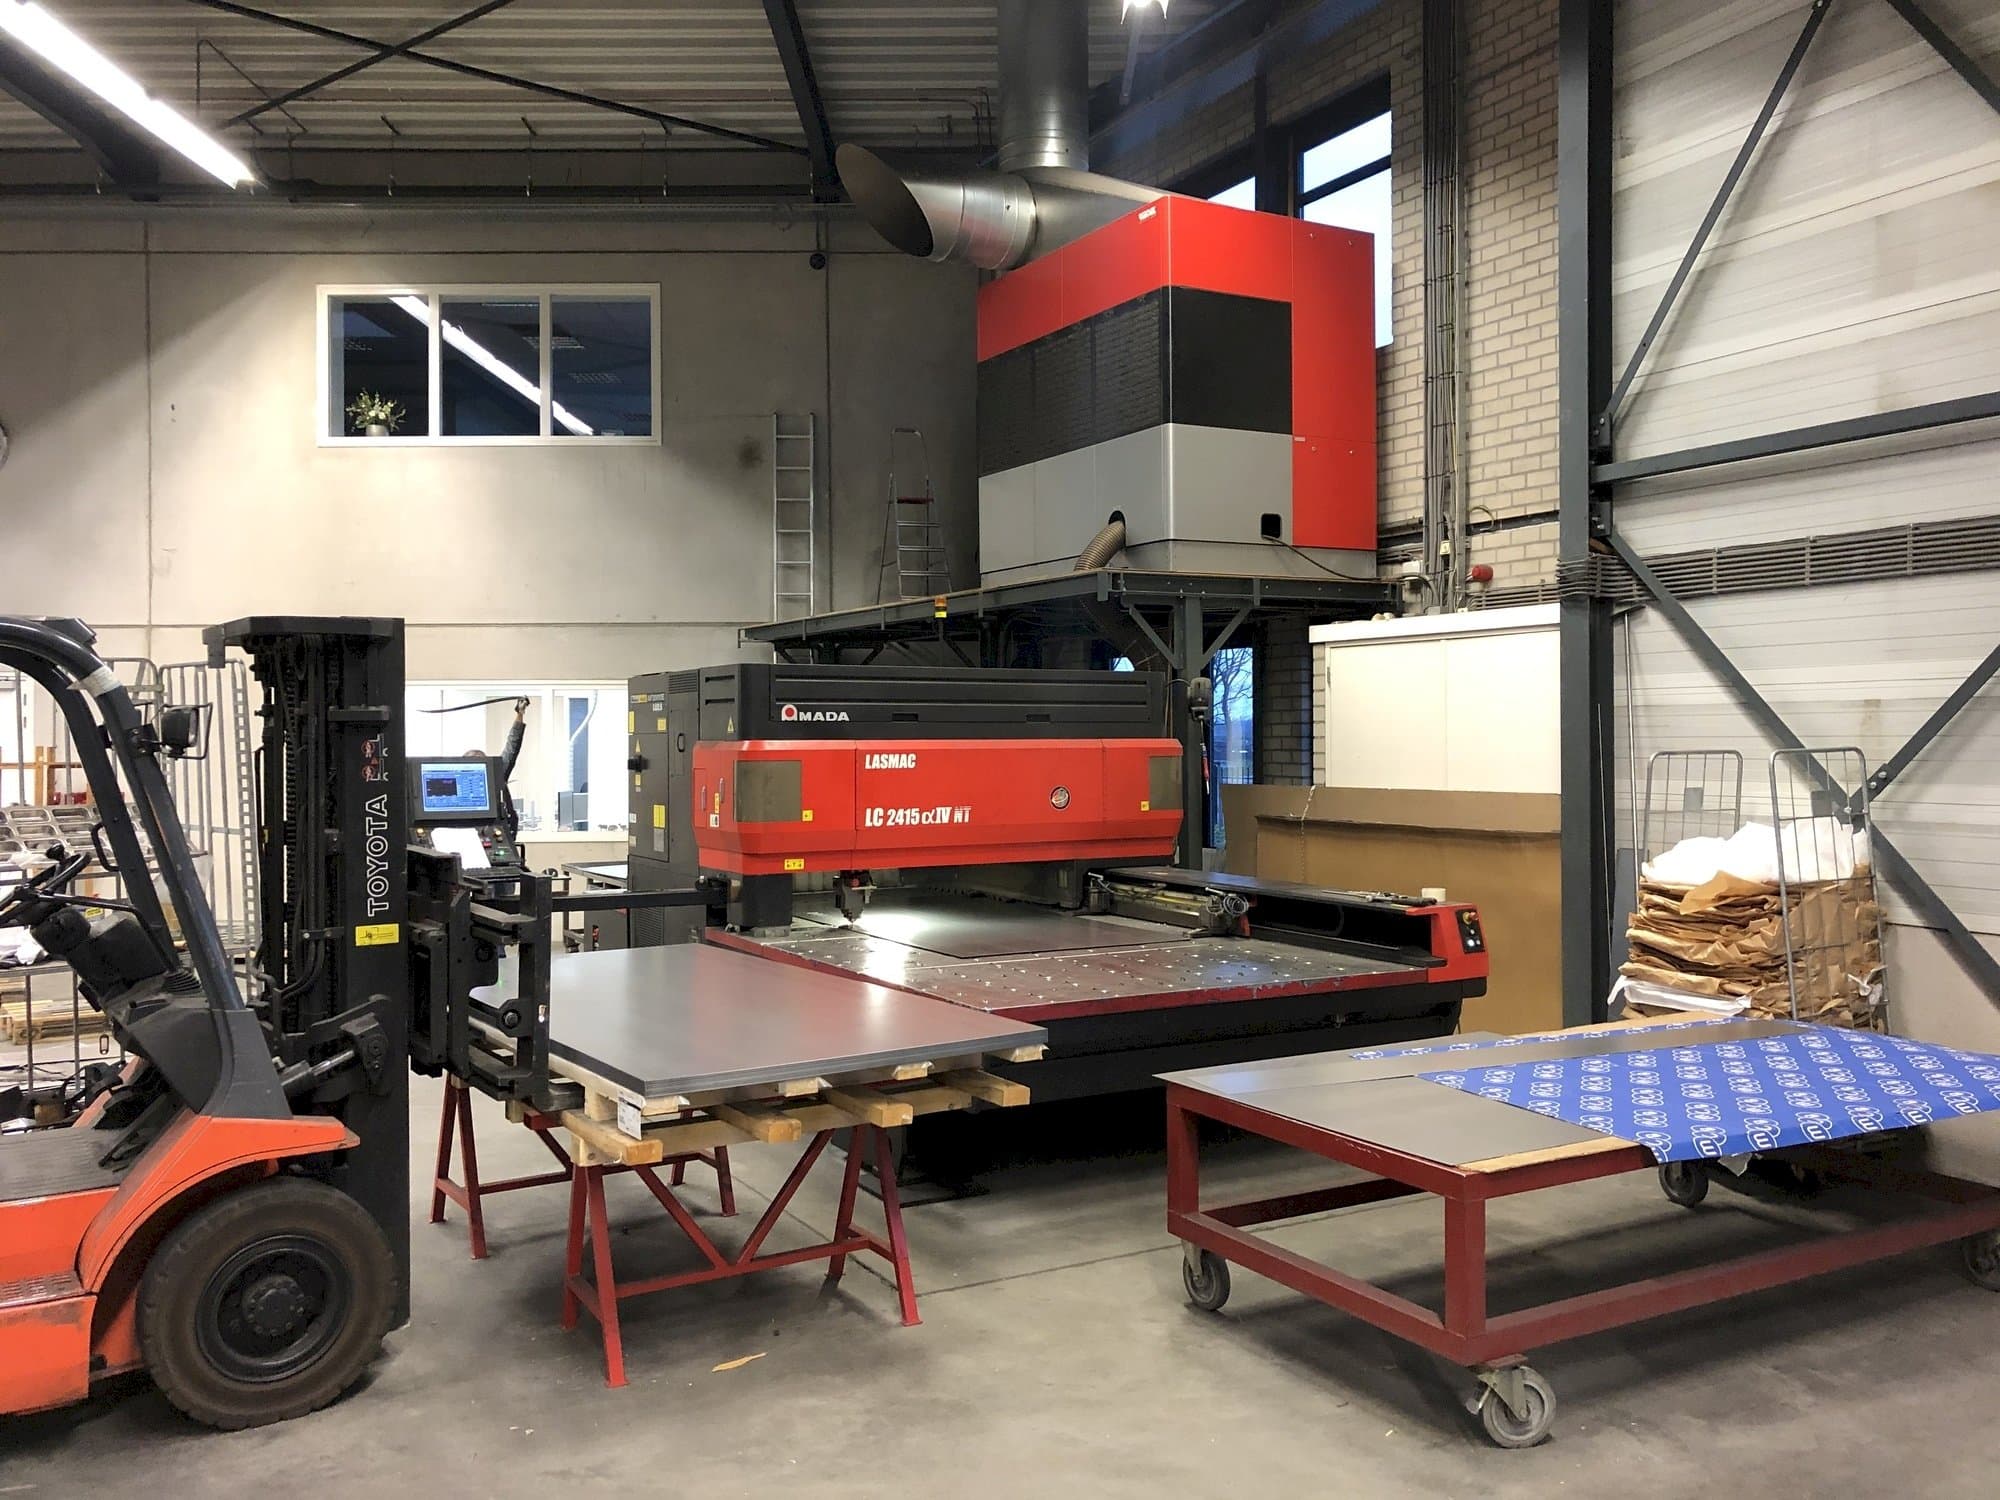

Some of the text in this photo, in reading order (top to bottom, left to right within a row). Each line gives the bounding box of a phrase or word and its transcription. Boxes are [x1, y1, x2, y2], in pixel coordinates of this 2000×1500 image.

[865, 753, 917, 769] LASMAC
[865, 807, 884, 827] LC
[886, 807, 920, 827] 2415
[366, 794, 389, 917] TOYOTA
